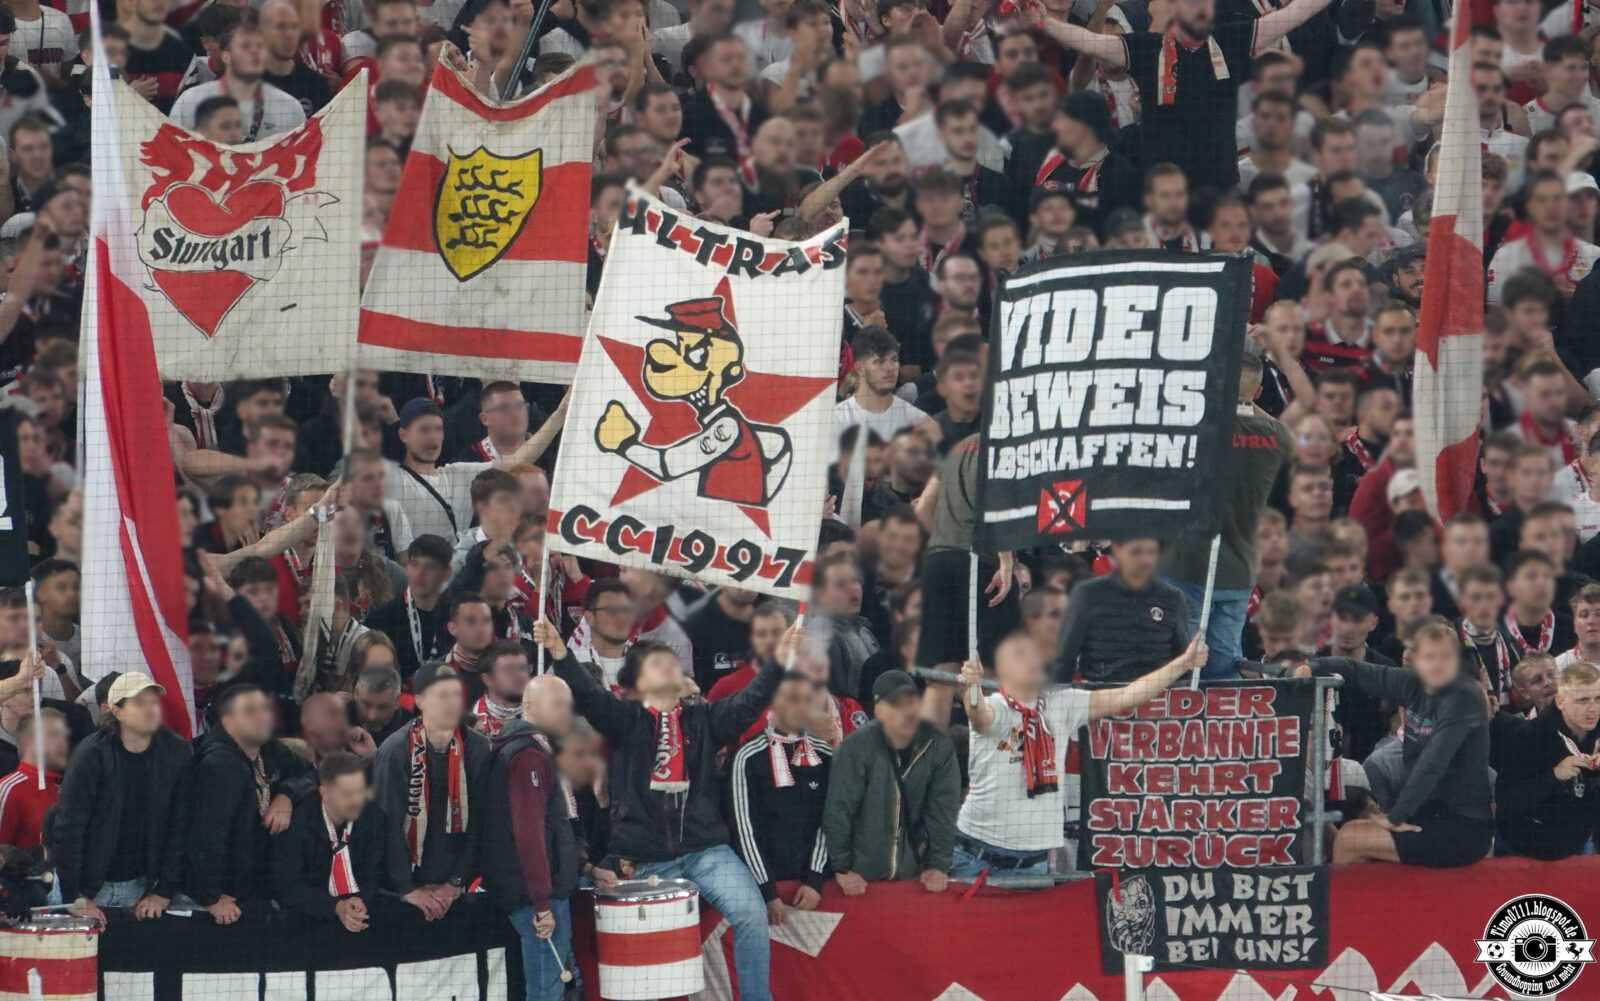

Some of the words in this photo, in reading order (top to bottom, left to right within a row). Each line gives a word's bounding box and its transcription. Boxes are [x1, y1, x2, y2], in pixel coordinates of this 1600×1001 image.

[619, 193, 847, 279] ULTRAS
[1001, 285, 1218, 371] VIDEO
[990, 368, 1207, 440] BEWEIS
[1088, 716, 1300, 761] VERBANNTE
[1108, 759, 1281, 795] KEHRT
[1092, 832, 1296, 868] ZURÜCK
[1162, 872, 1216, 902] DU
[1232, 872, 1316, 902] BIST
[1165, 903, 1315, 936] IMMER
[1165, 936, 1219, 963] BEI
[1234, 937, 1319, 963] UNS!
